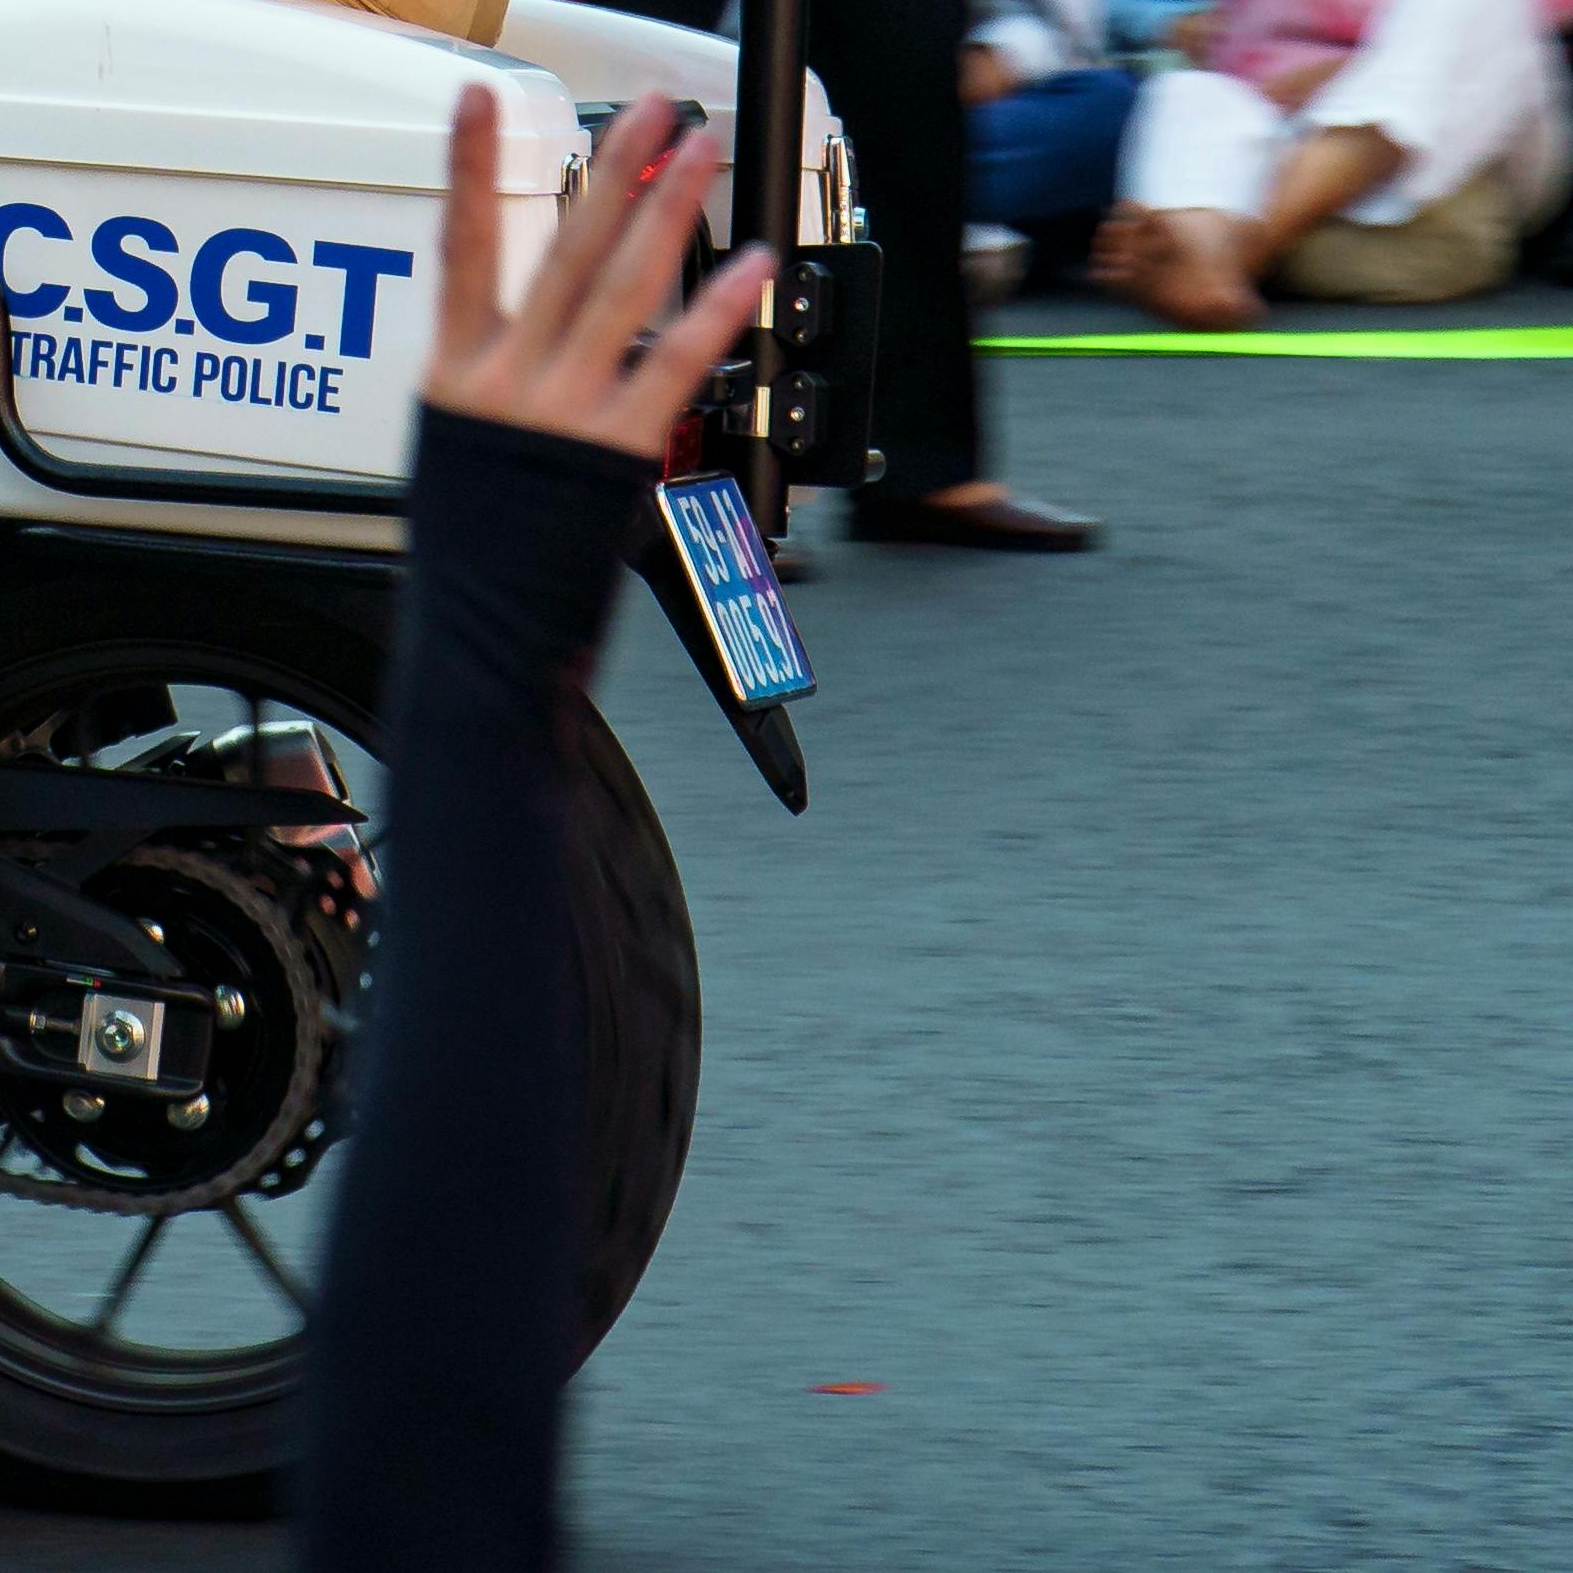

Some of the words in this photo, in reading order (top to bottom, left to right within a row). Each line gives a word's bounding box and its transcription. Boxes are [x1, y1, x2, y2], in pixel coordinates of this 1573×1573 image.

[11, 331, 179, 393] TRAFFIC
[192, 352, 344, 414] POLICE
[677, 489, 761, 586] 59-A1
[716, 588, 803, 690] 005.97
